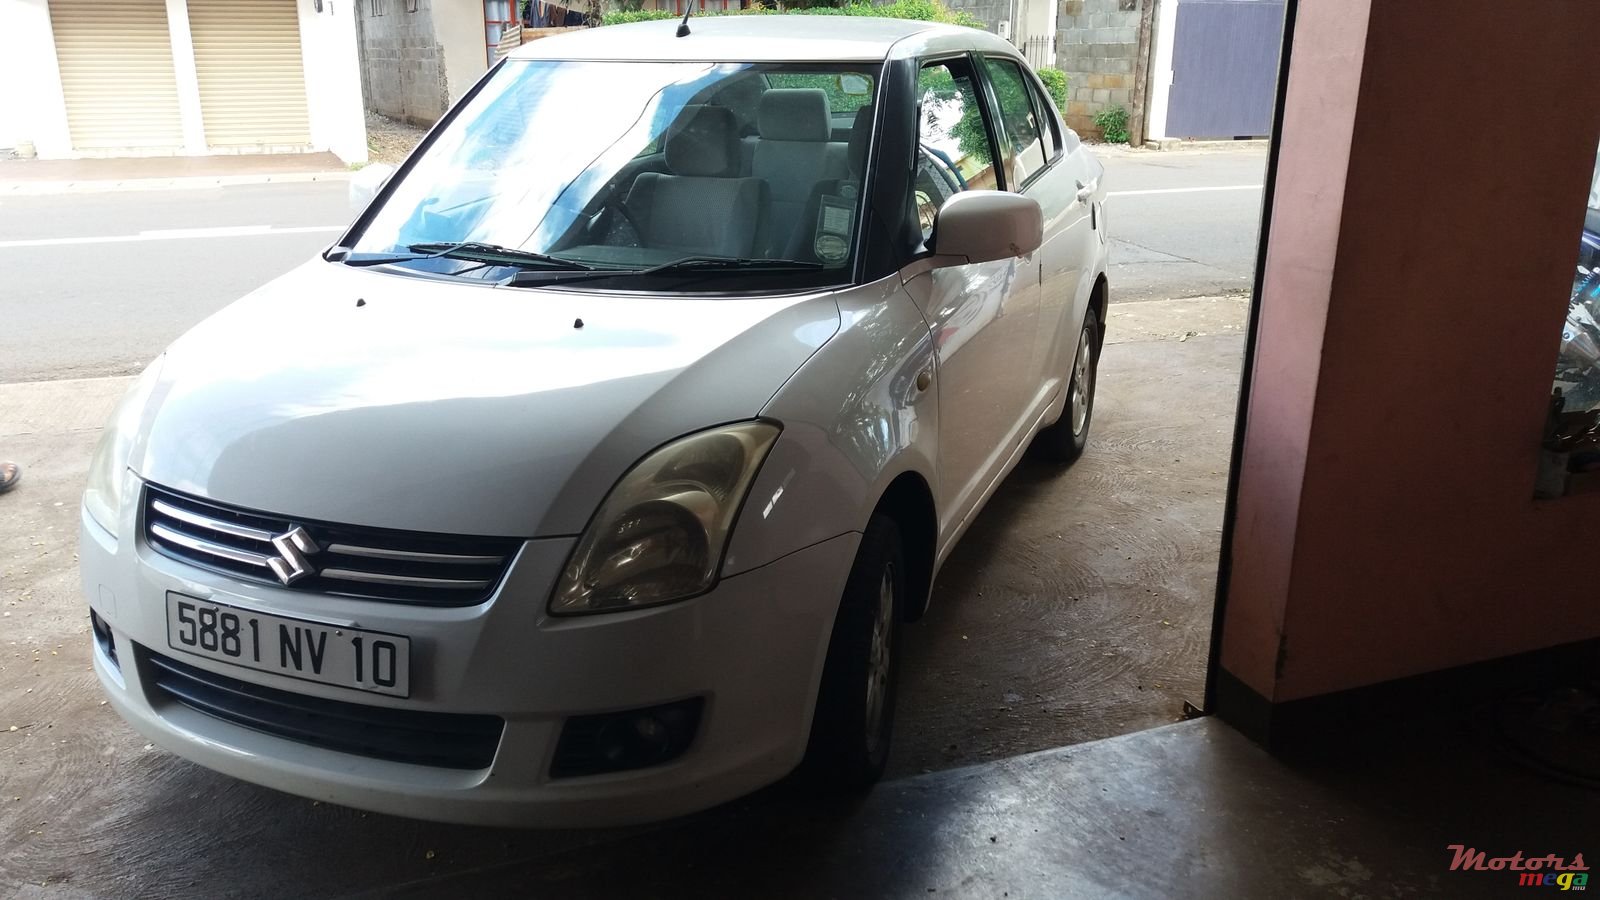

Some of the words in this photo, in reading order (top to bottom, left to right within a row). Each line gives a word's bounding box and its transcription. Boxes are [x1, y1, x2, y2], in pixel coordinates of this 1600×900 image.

[178, 601, 260, 662] 5881
[279, 624, 327, 674] NV
[352, 637, 396, 687] 10
